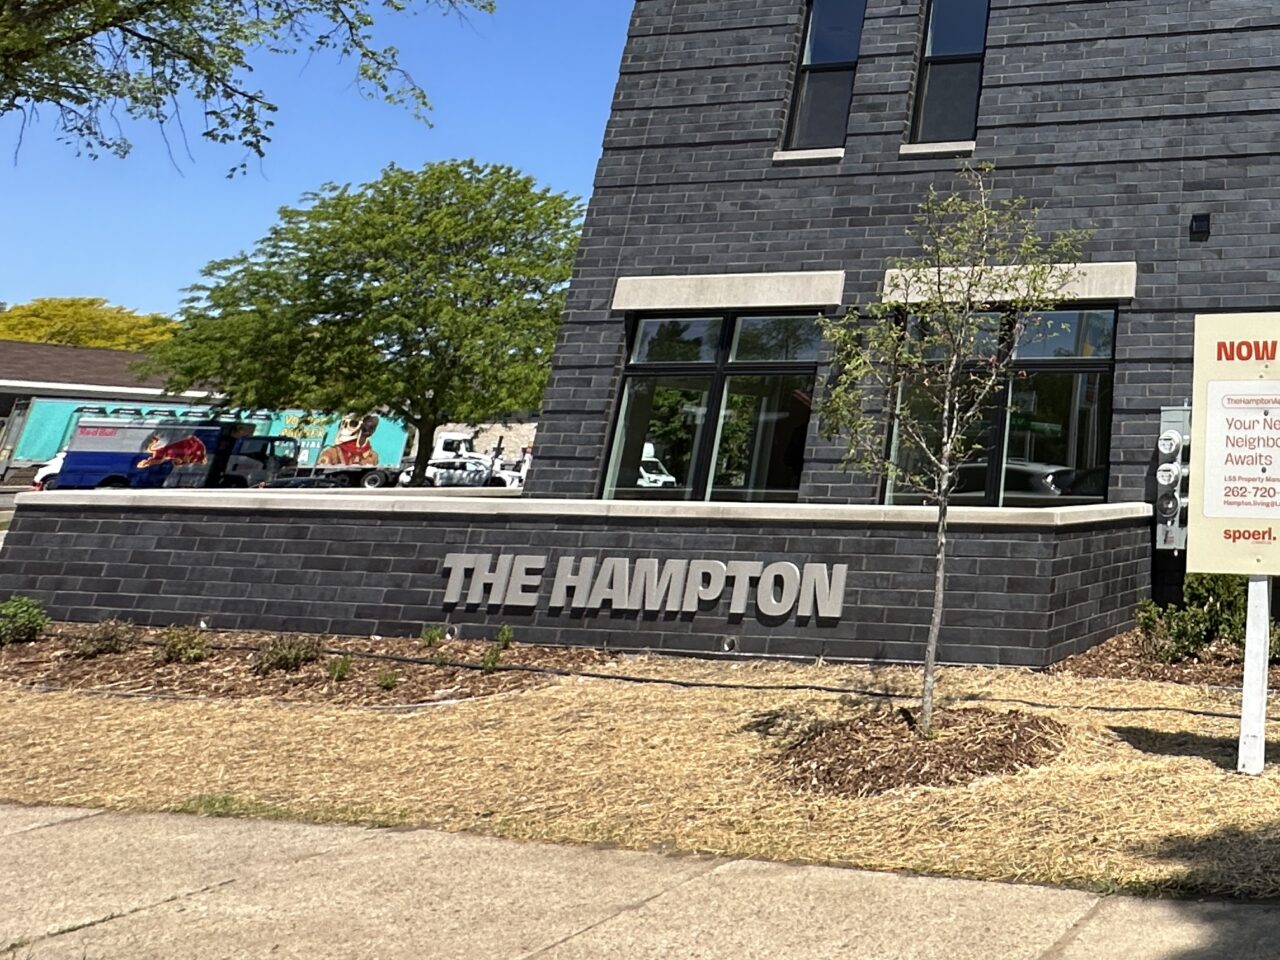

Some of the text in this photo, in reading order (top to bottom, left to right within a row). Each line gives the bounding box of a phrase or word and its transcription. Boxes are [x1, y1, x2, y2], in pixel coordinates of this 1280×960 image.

[1216, 340, 1277, 361] NOW
[1225, 417, 1260, 431] Your
[1224, 452, 1273, 466] Awaits
[1237, 475, 1264, 483] Property
[1223, 527, 1277, 543] spoerl.
[442, 553, 849, 618] THE HAMPTON
